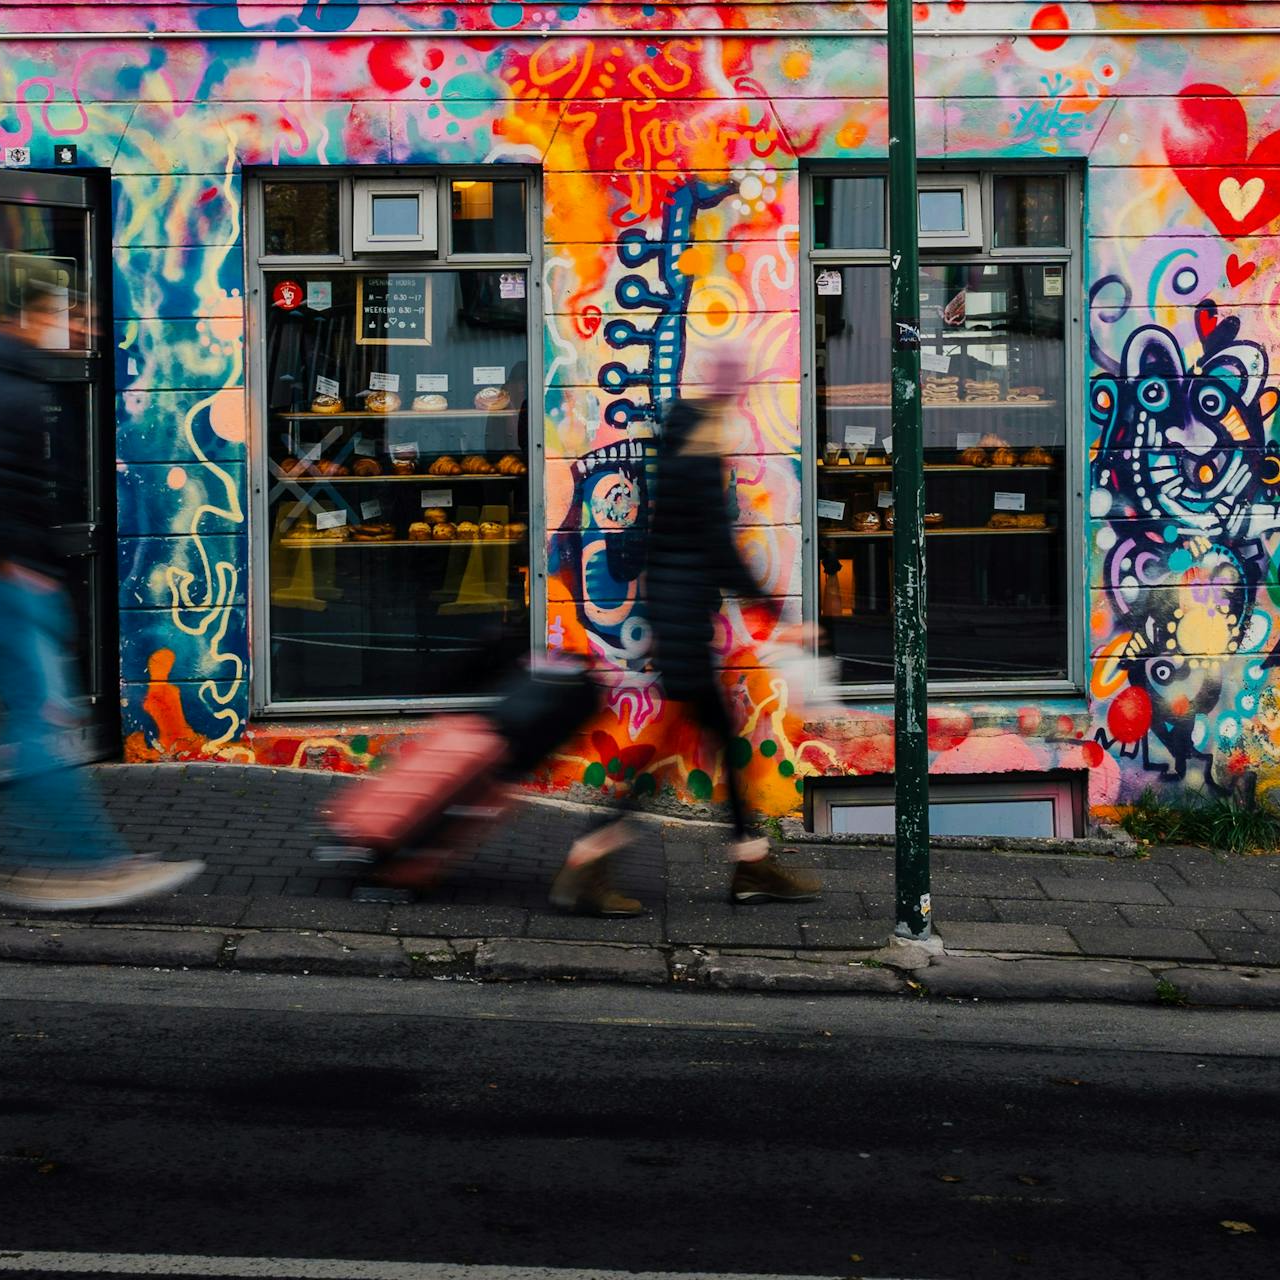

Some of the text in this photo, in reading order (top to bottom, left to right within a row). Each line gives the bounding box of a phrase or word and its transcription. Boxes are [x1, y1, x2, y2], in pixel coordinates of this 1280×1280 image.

[368, 279, 417, 287] OPENING HOURS
[364, 306, 396, 314] WEEKEND
